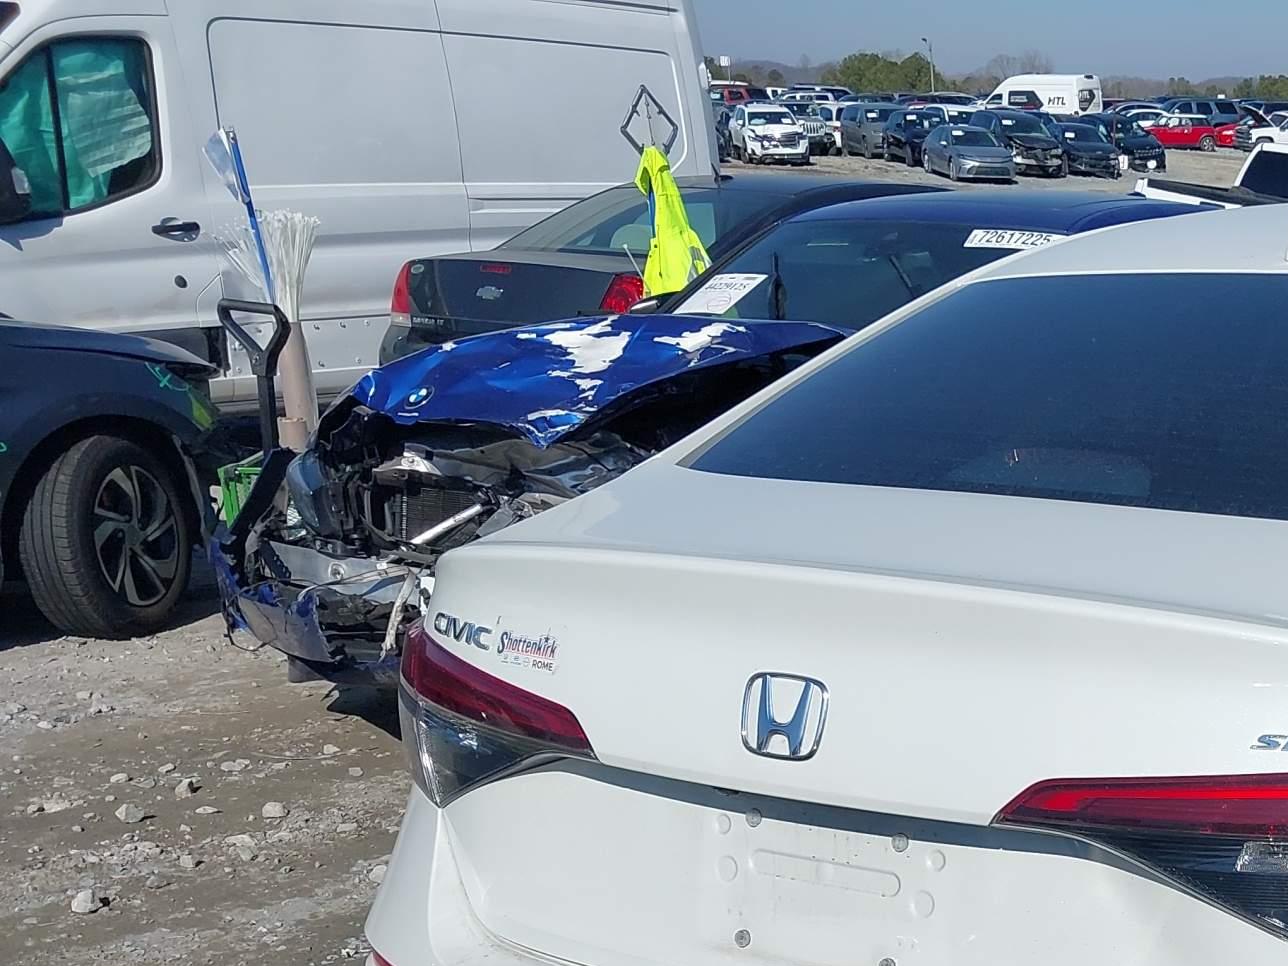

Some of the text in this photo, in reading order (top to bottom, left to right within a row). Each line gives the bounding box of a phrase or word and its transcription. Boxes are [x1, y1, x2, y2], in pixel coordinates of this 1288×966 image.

[1047, 96, 1067, 106] HTL
[977, 230, 1053, 247] 72617225
[434, 612, 492, 651] CIVIC
[497, 631, 558, 659] Shottenkirk
[531, 659, 553, 672] ROME
